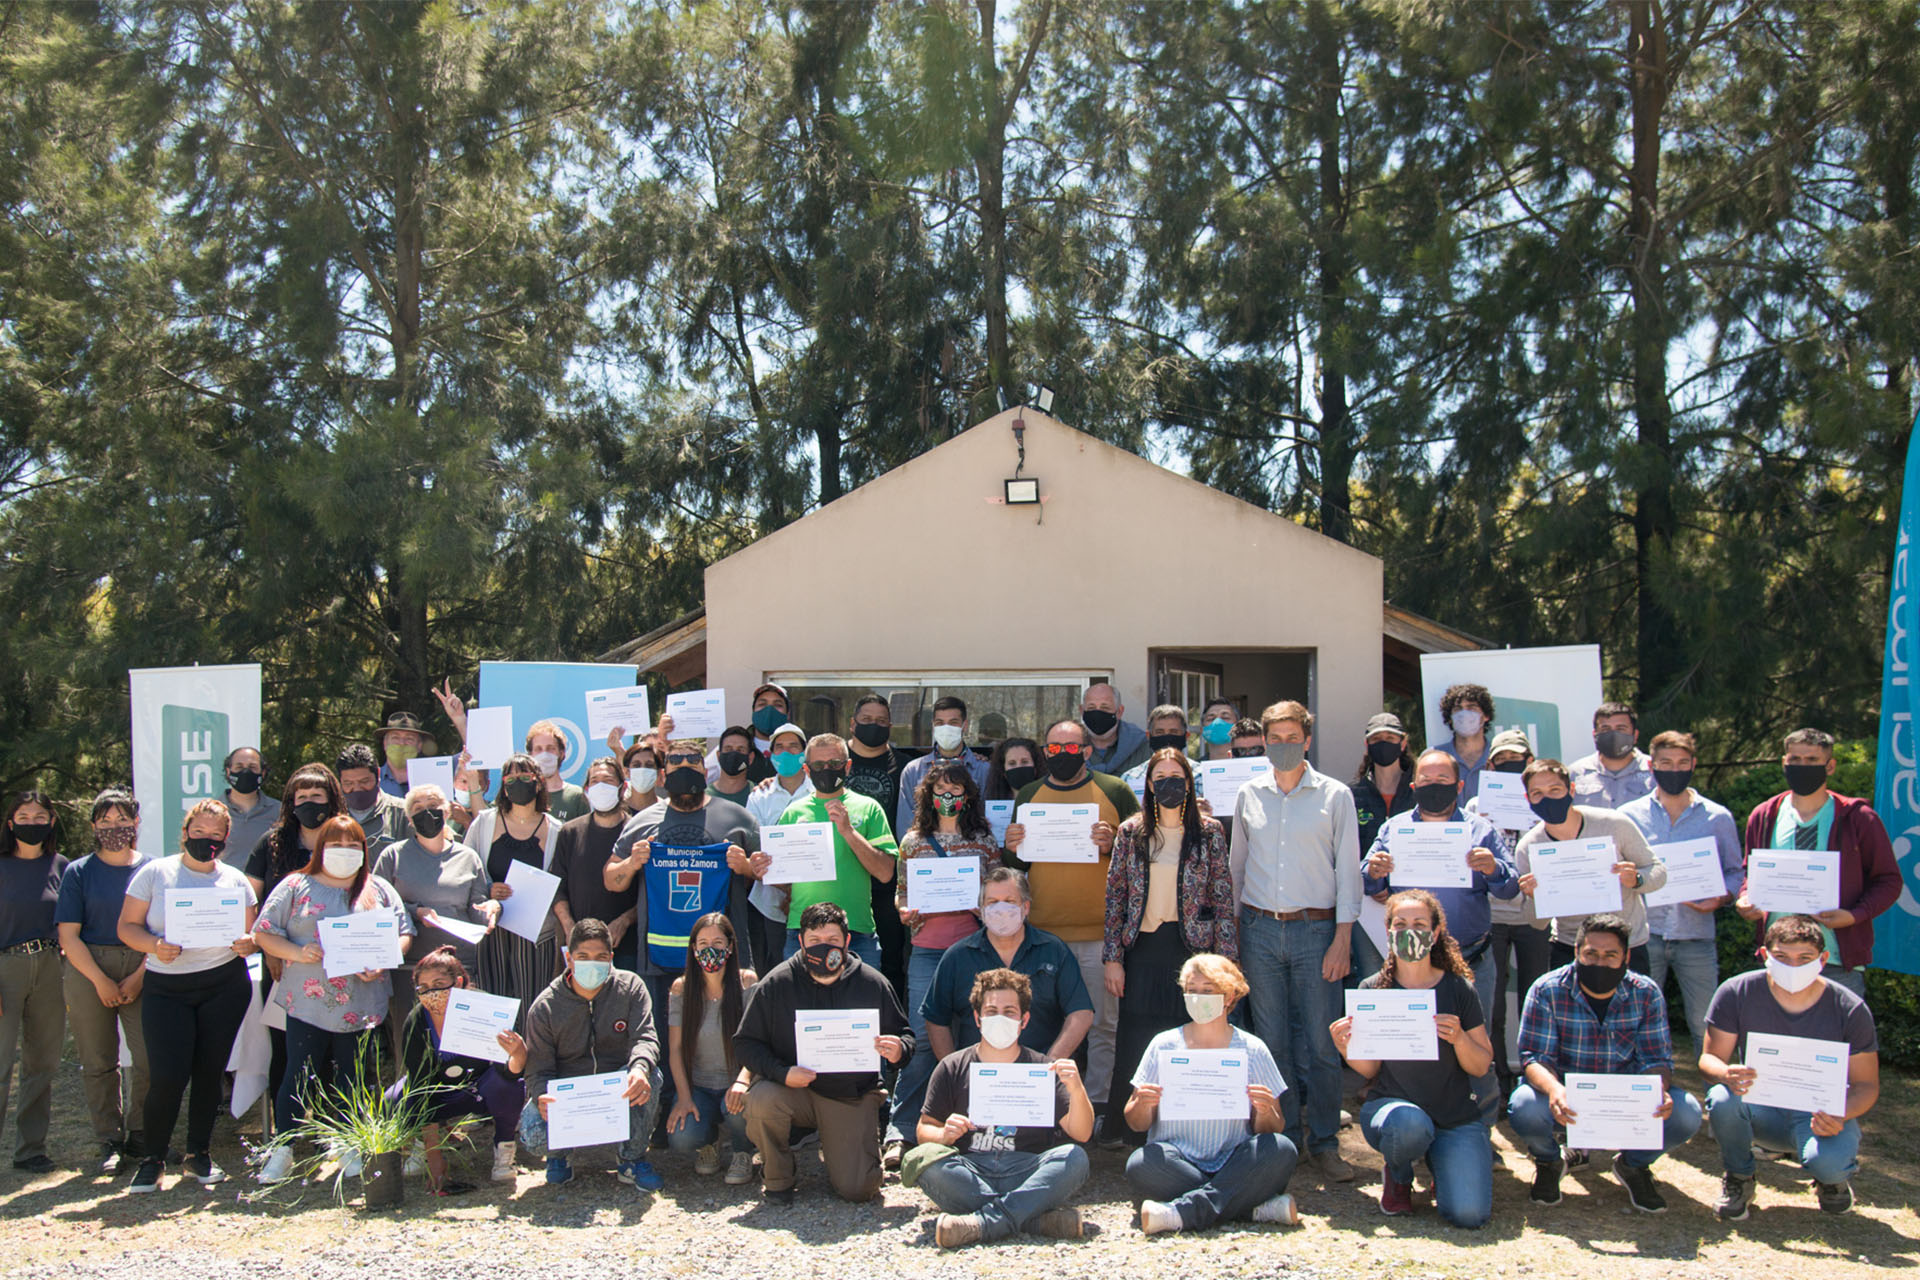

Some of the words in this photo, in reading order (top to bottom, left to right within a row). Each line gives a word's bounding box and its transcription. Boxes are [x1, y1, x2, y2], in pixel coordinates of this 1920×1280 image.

[668, 848, 703, 858] Municipio
[652, 858, 678, 867] Lomas
[679, 858, 689, 867] de
[690, 858, 718, 868] Zamora
[968, 1132, 1016, 1152] BOSS
